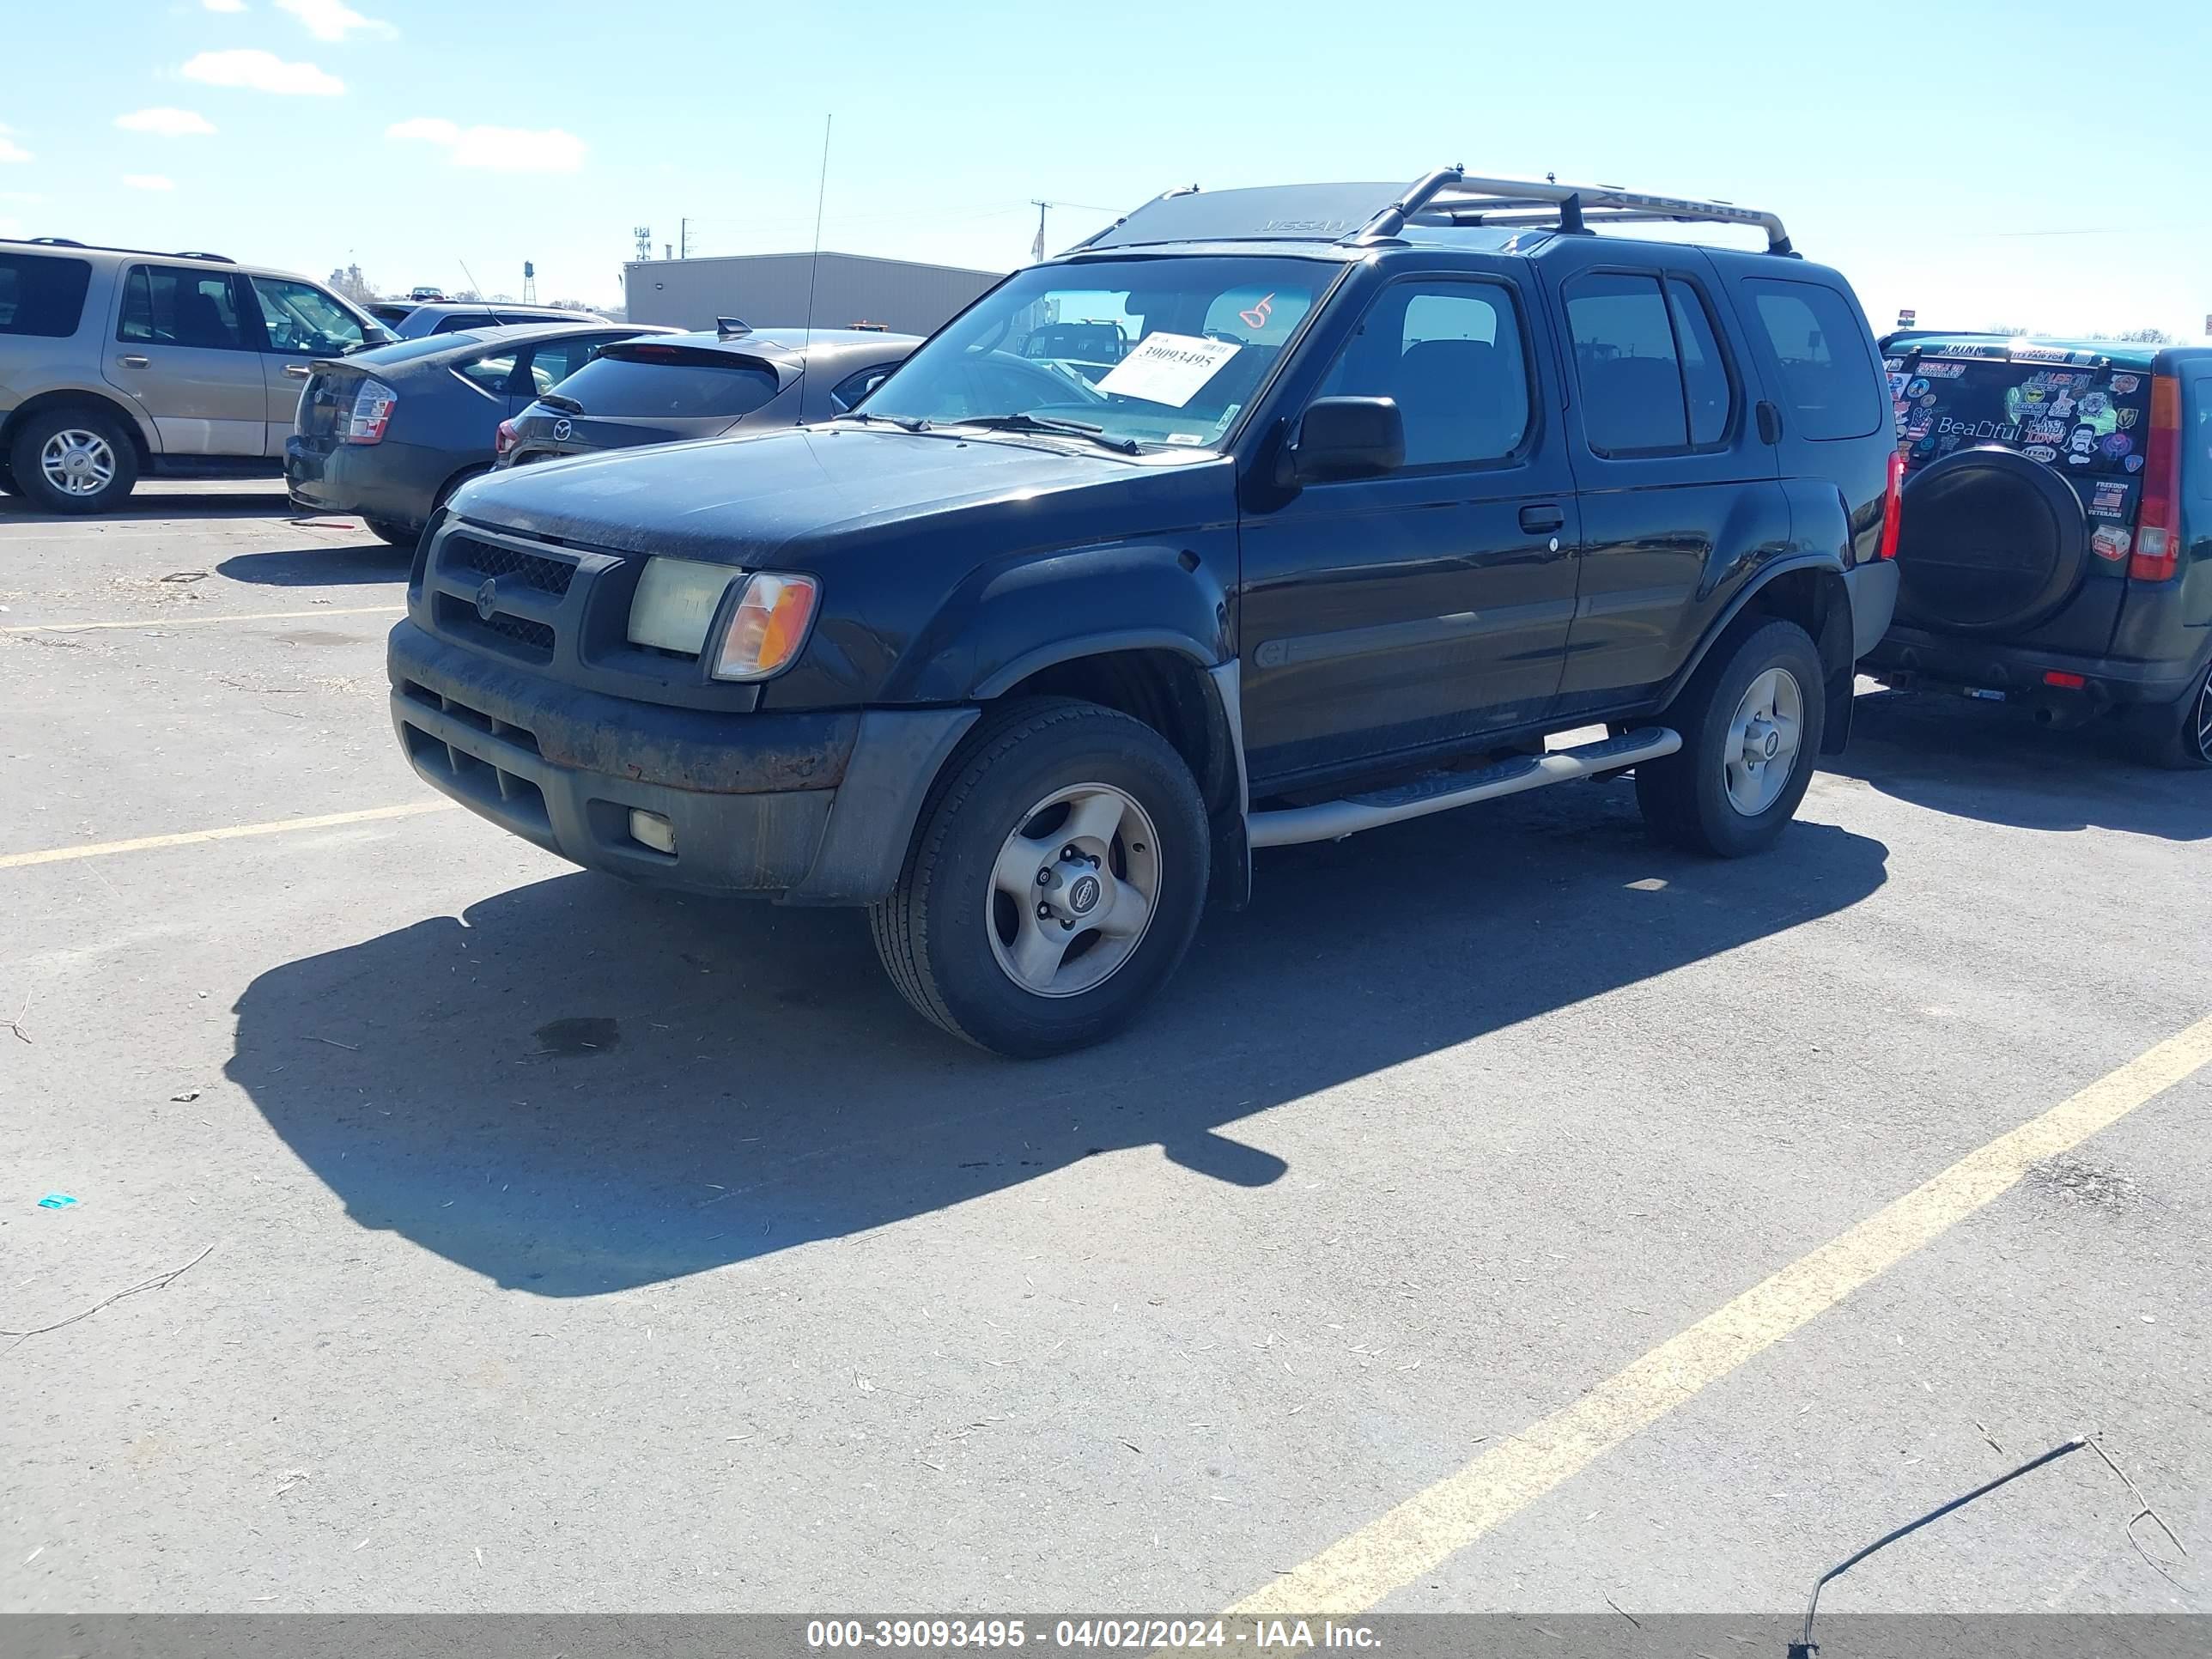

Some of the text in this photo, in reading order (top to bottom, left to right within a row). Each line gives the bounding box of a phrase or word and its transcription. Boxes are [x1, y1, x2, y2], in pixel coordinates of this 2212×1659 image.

[1253, 220, 1352, 232] NISSAN
[1944, 343, 1985, 353] THINK
[1139, 345, 1216, 368] 39093495
[2033, 415, 2060, 427] Live
[2024, 432, 2063, 444] Love
[2096, 481, 2129, 489] FREEDOM
